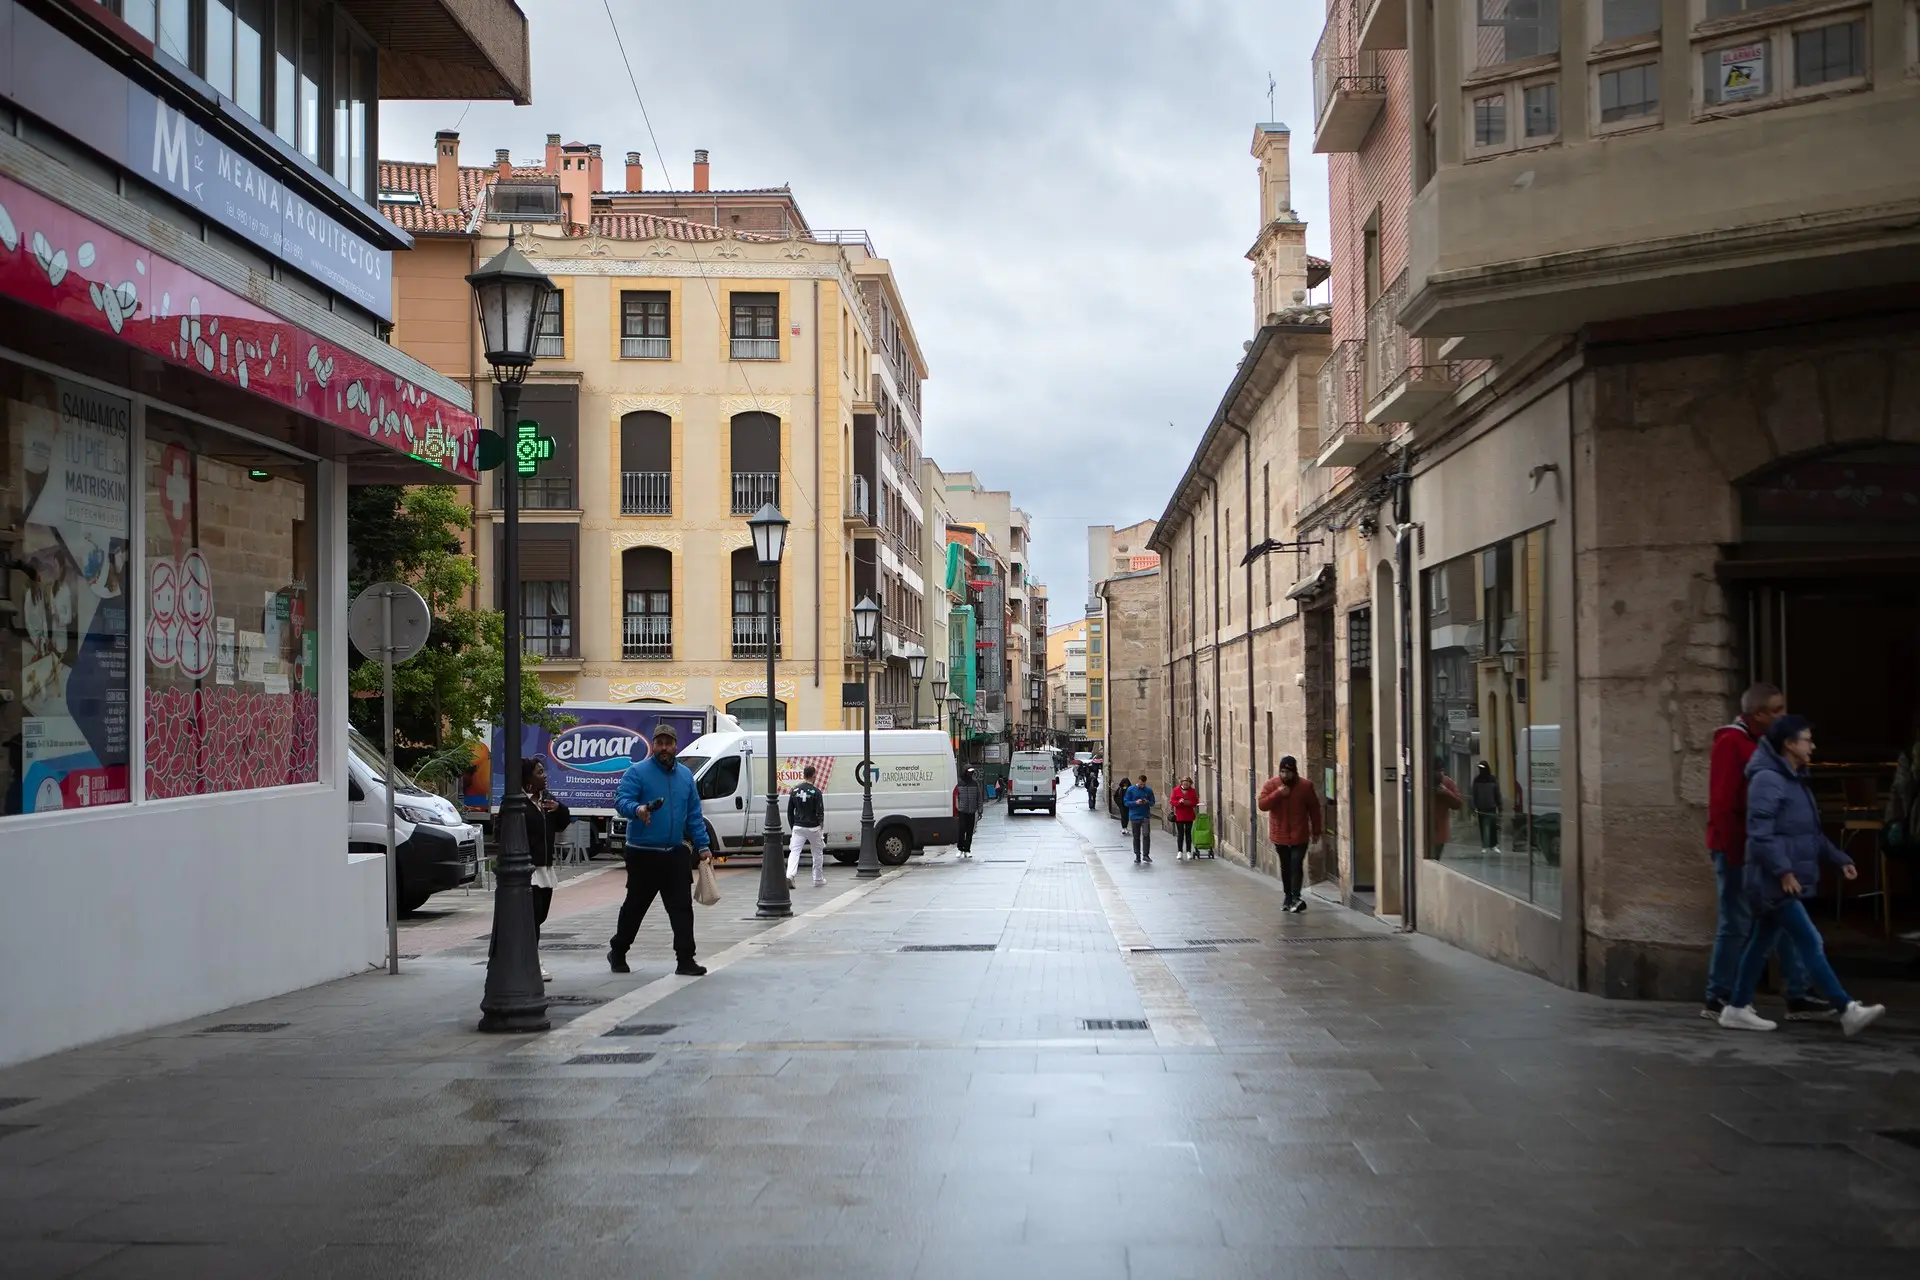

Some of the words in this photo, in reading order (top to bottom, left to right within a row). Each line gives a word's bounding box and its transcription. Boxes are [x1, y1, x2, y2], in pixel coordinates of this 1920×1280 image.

[152, 96, 190, 192] M
[218, 148, 281, 213] MEANA
[285, 196, 381, 280] ARQUITECTOS
[62, 392, 127, 440] SANAMOS
[63, 431, 81, 464] TU
[85, 436, 112, 472] PIEL
[65, 469, 126, 502] MATRISKIN
[557, 734, 639, 759] elmar
[776, 769, 804, 781] RÉSIDE
[882, 770, 933, 782] GARCÍAGONZÁLEZ
